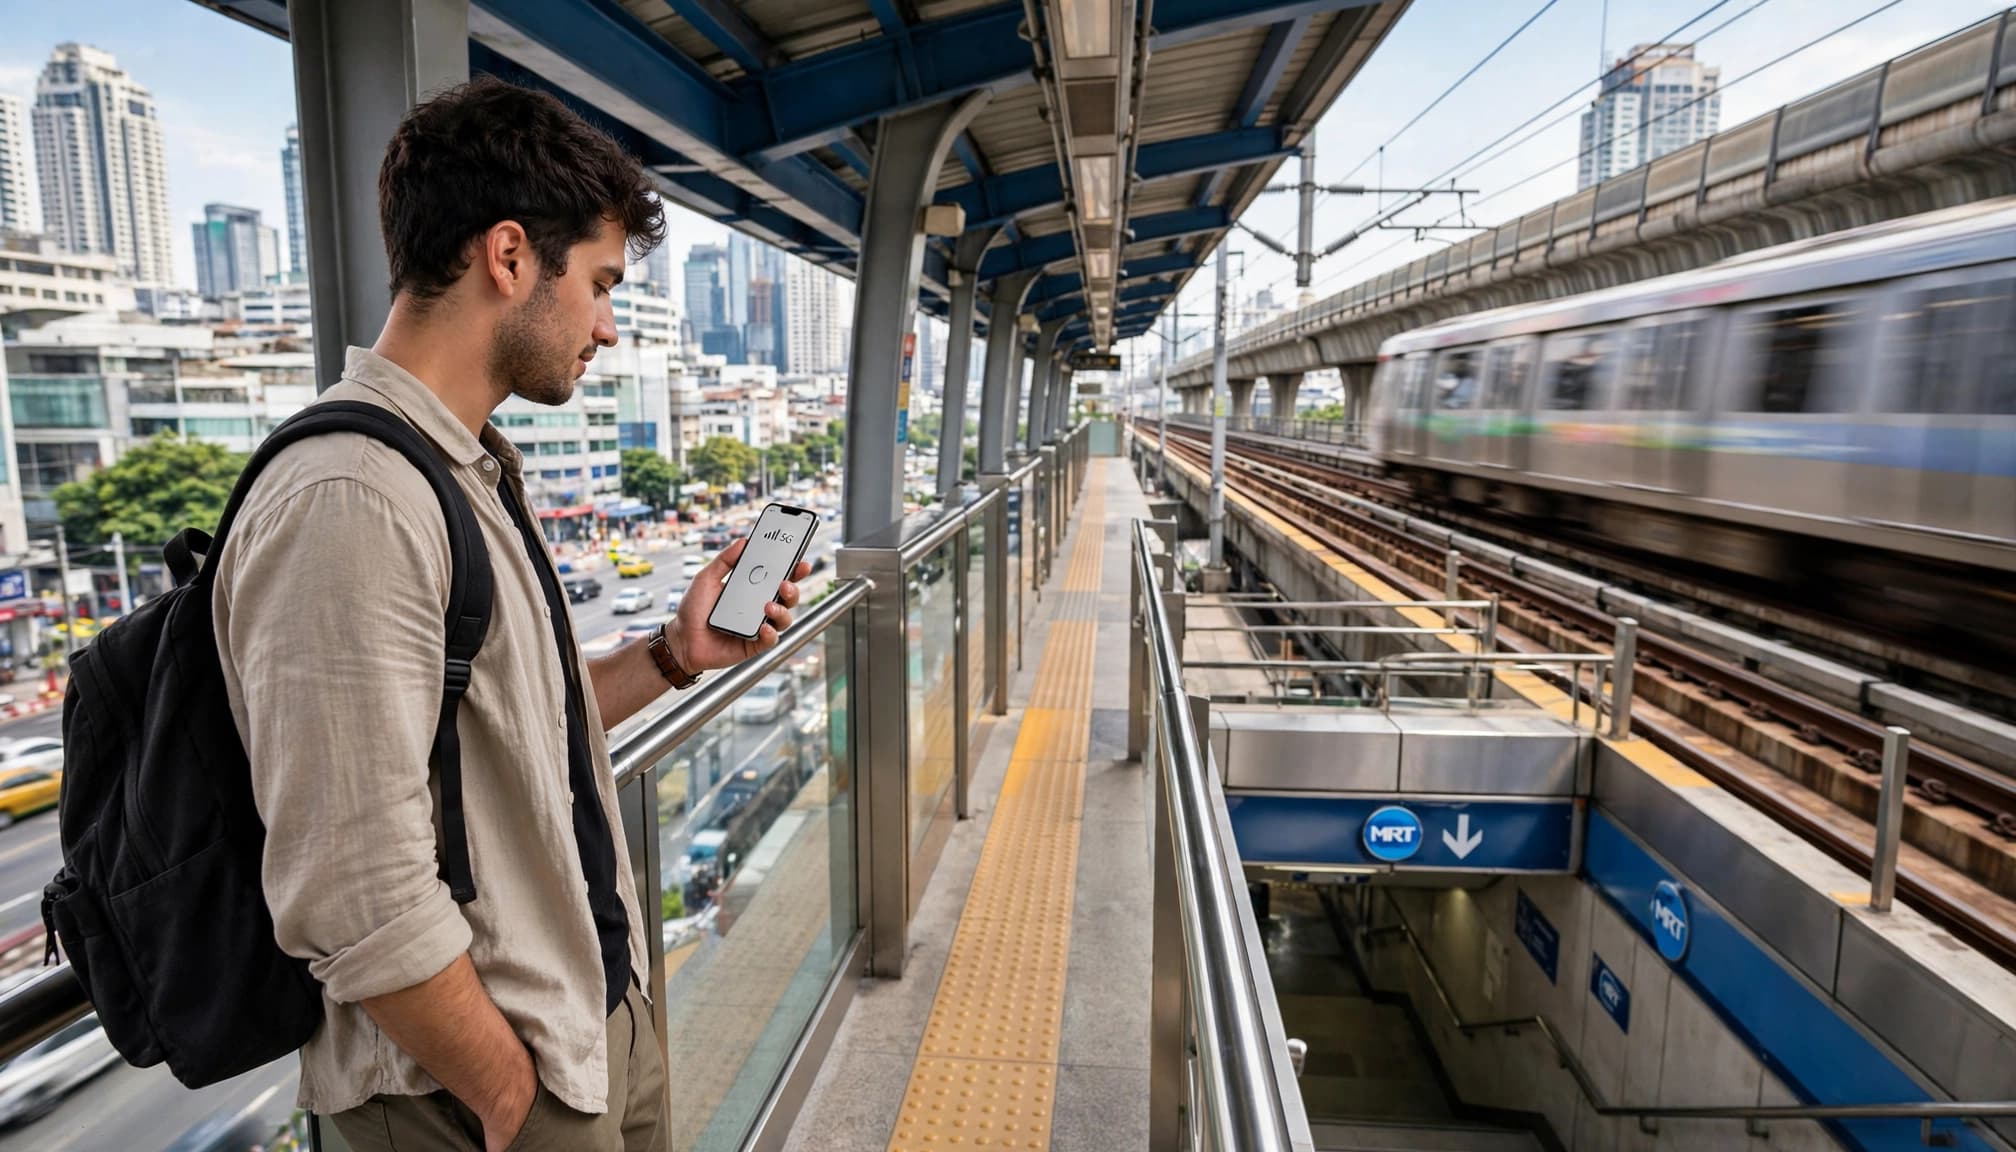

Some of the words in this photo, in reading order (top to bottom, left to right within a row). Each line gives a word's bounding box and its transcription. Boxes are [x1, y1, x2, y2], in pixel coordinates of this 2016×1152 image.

[780, 533, 794, 543] 5G
[1370, 825, 1416, 842] MRT
[1655, 899, 1686, 941] MRT
